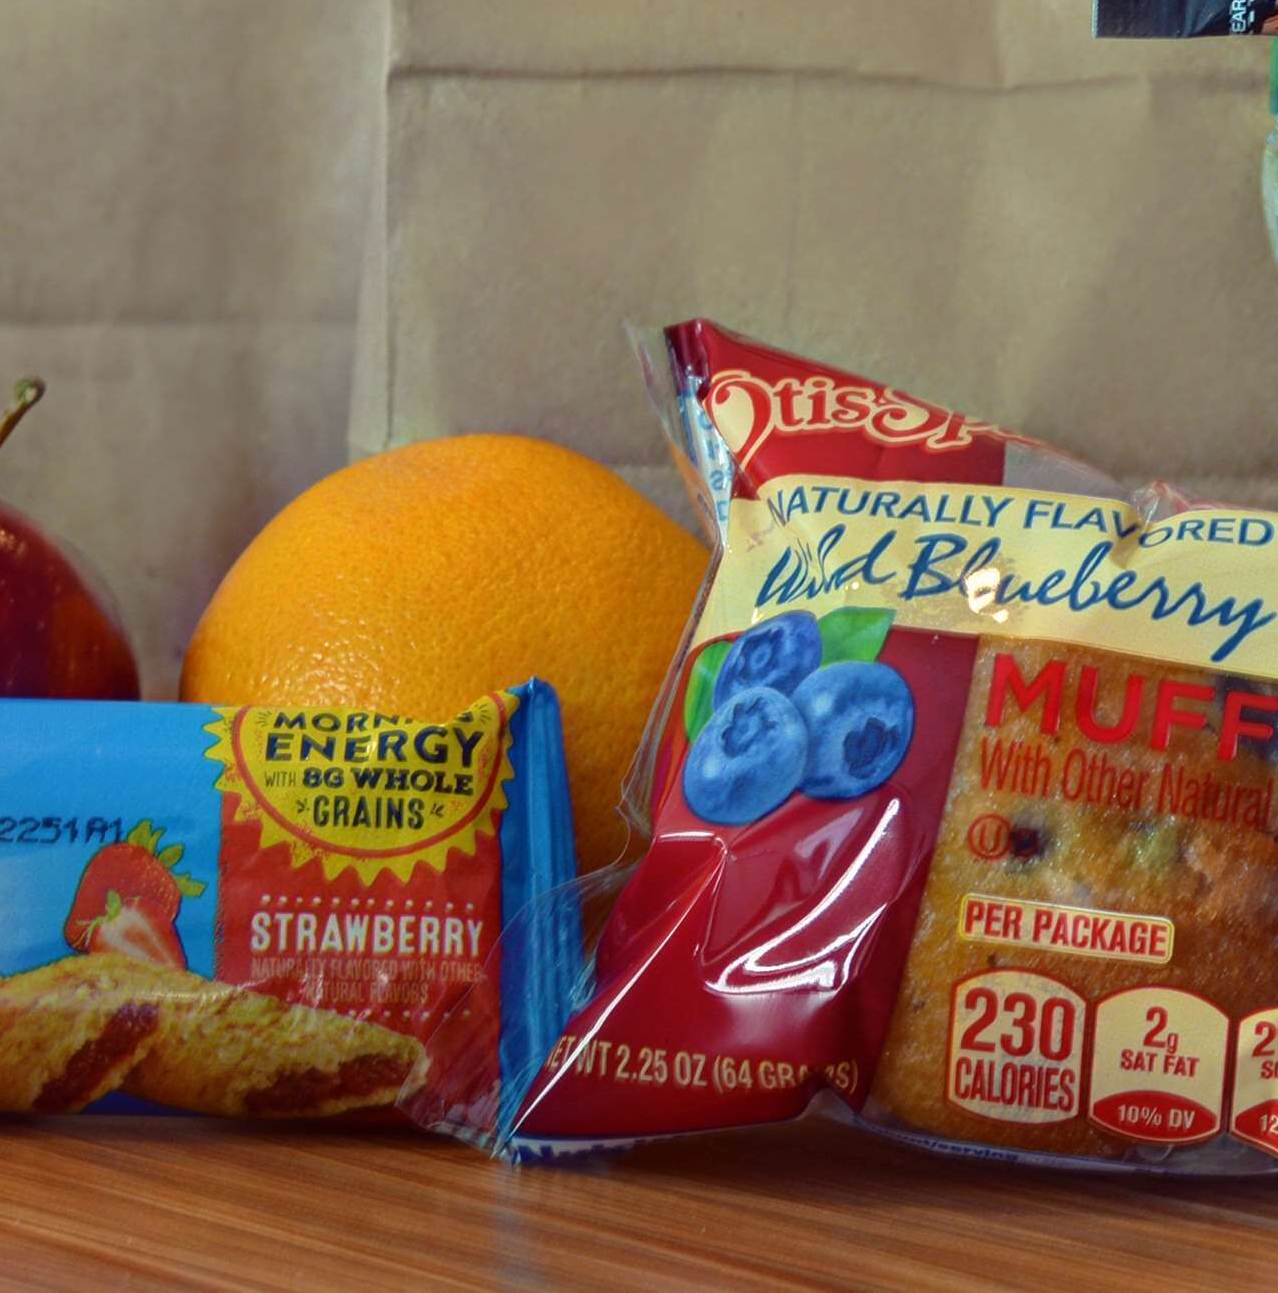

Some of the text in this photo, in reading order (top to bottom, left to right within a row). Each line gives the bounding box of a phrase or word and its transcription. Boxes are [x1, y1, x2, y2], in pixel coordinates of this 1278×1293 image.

[1231, 0, 1248, 34] EAR
[766, 484, 1276, 548] NATURALLY FLAVORED
[899, 531, 1278, 663] Blueberry
[266, 726, 484, 768] ENERGY
[264, 767, 474, 796] WITH 8G WHOLE
[979, 736, 1051, 796] With
[1062, 748, 1150, 805] Other
[1155, 764, 1273, 828] Natural
[313, 795, 425, 830] GRAINS
[251, 912, 483, 956] STRAWBERRY
[964, 900, 1168, 958] PER PACKAGE
[961, 987, 1077, 1060] 230
[1142, 1006, 1179, 1055] 2g
[578, 1041, 612, 1077] WT
[615, 1049, 668, 1084] 2.25
[678, 1051, 708, 1087] OZ
[714, 1054, 754, 1093] (64
[954, 1056, 1076, 1113] CALORIES
[1121, 1049, 1200, 1079] SAT FAT
[1118, 1104, 1197, 1131] 10% DV
